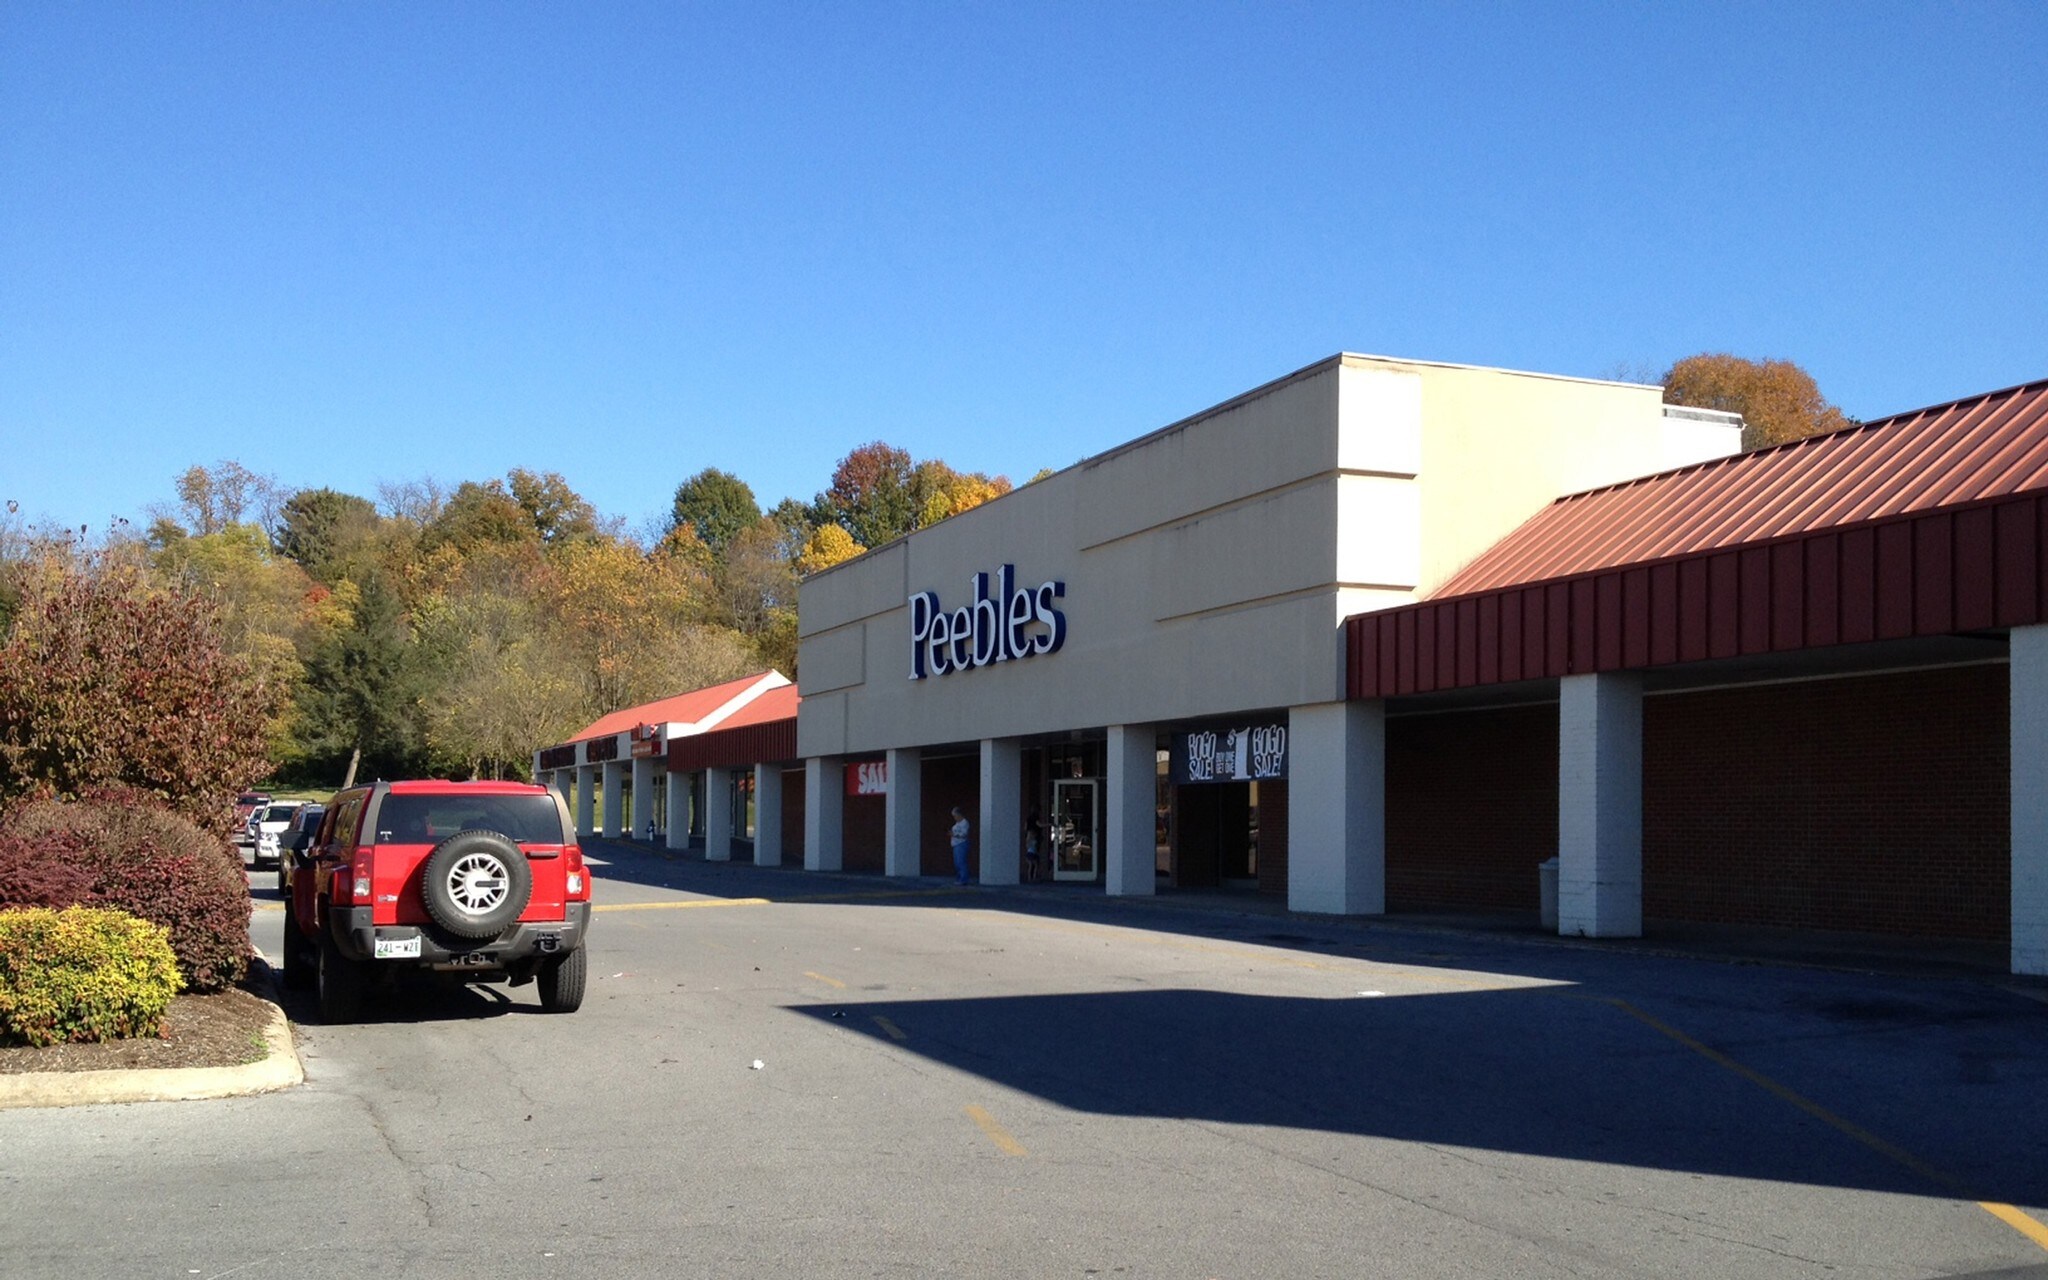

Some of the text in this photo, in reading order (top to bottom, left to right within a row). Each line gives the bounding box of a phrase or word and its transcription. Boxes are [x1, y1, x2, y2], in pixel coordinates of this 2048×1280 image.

[908, 564, 1066, 681] Peebles
[1188, 731, 1217, 761] BOGO
[1253, 724, 1285, 756] BOGO
[858, 762, 888, 794] SAL
[1189, 759, 1214, 781] SALE!
[1254, 753, 1283, 778] SALE!
